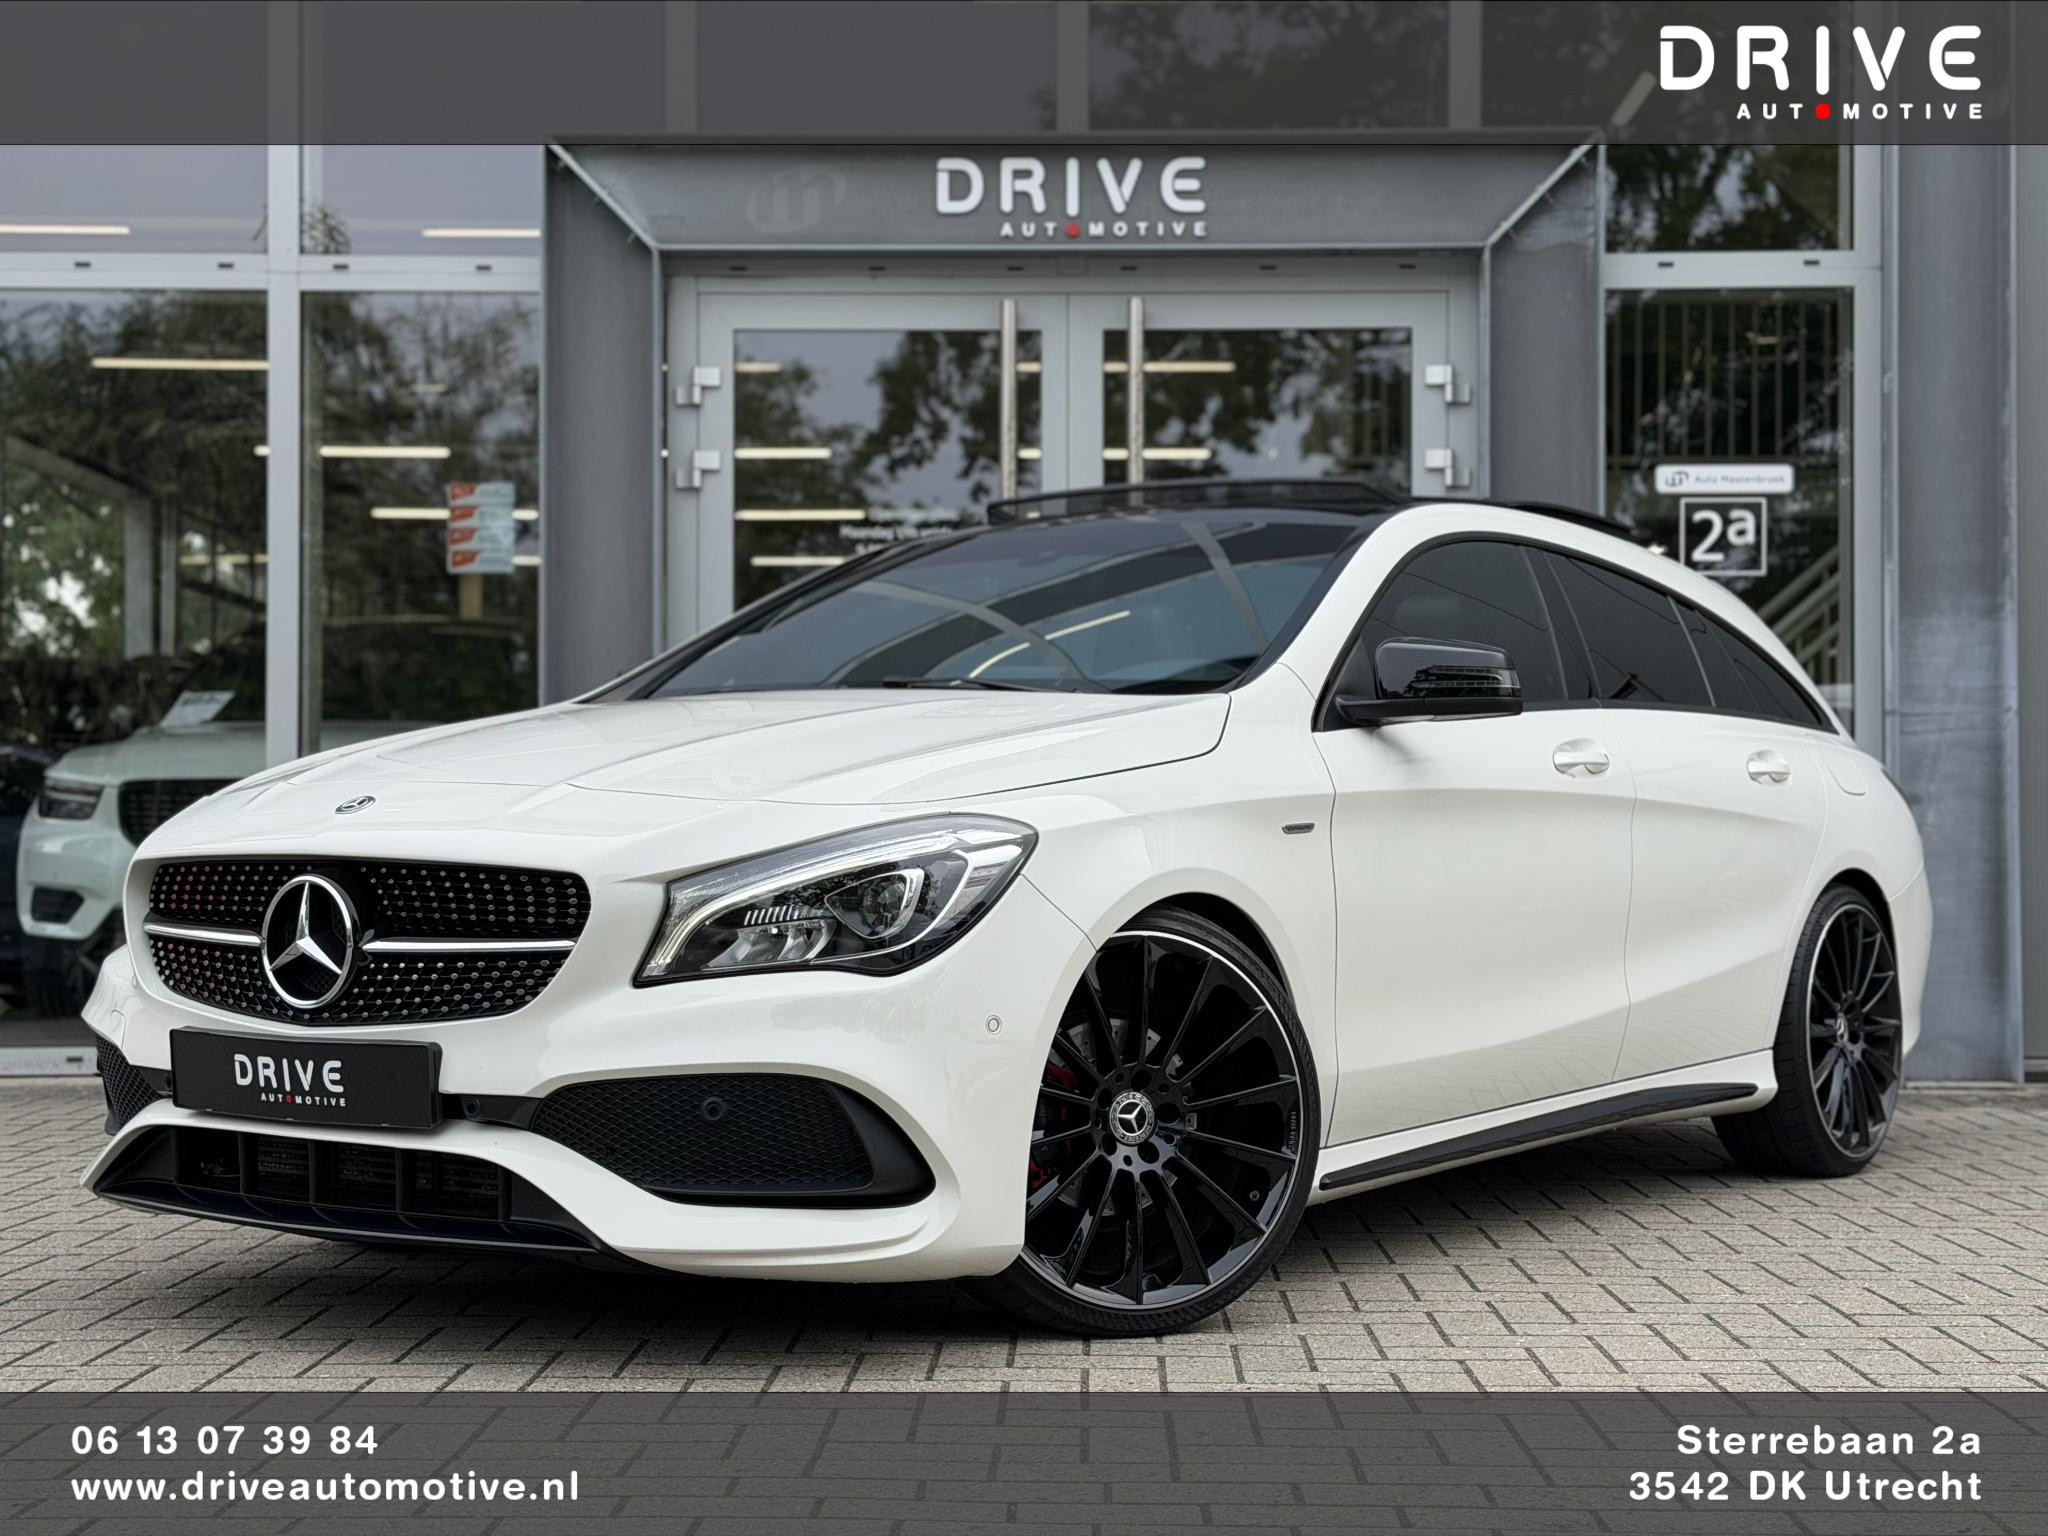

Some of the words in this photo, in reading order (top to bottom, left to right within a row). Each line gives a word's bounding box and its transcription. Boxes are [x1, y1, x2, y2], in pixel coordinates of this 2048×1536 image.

[936, 157, 1207, 217] DRIVE
[1000, 221, 1208, 237] AUTOMOTIVE
[233, 1053, 344, 1093] DRIVE
[261, 1091, 347, 1107] AUTOMOTIVE
